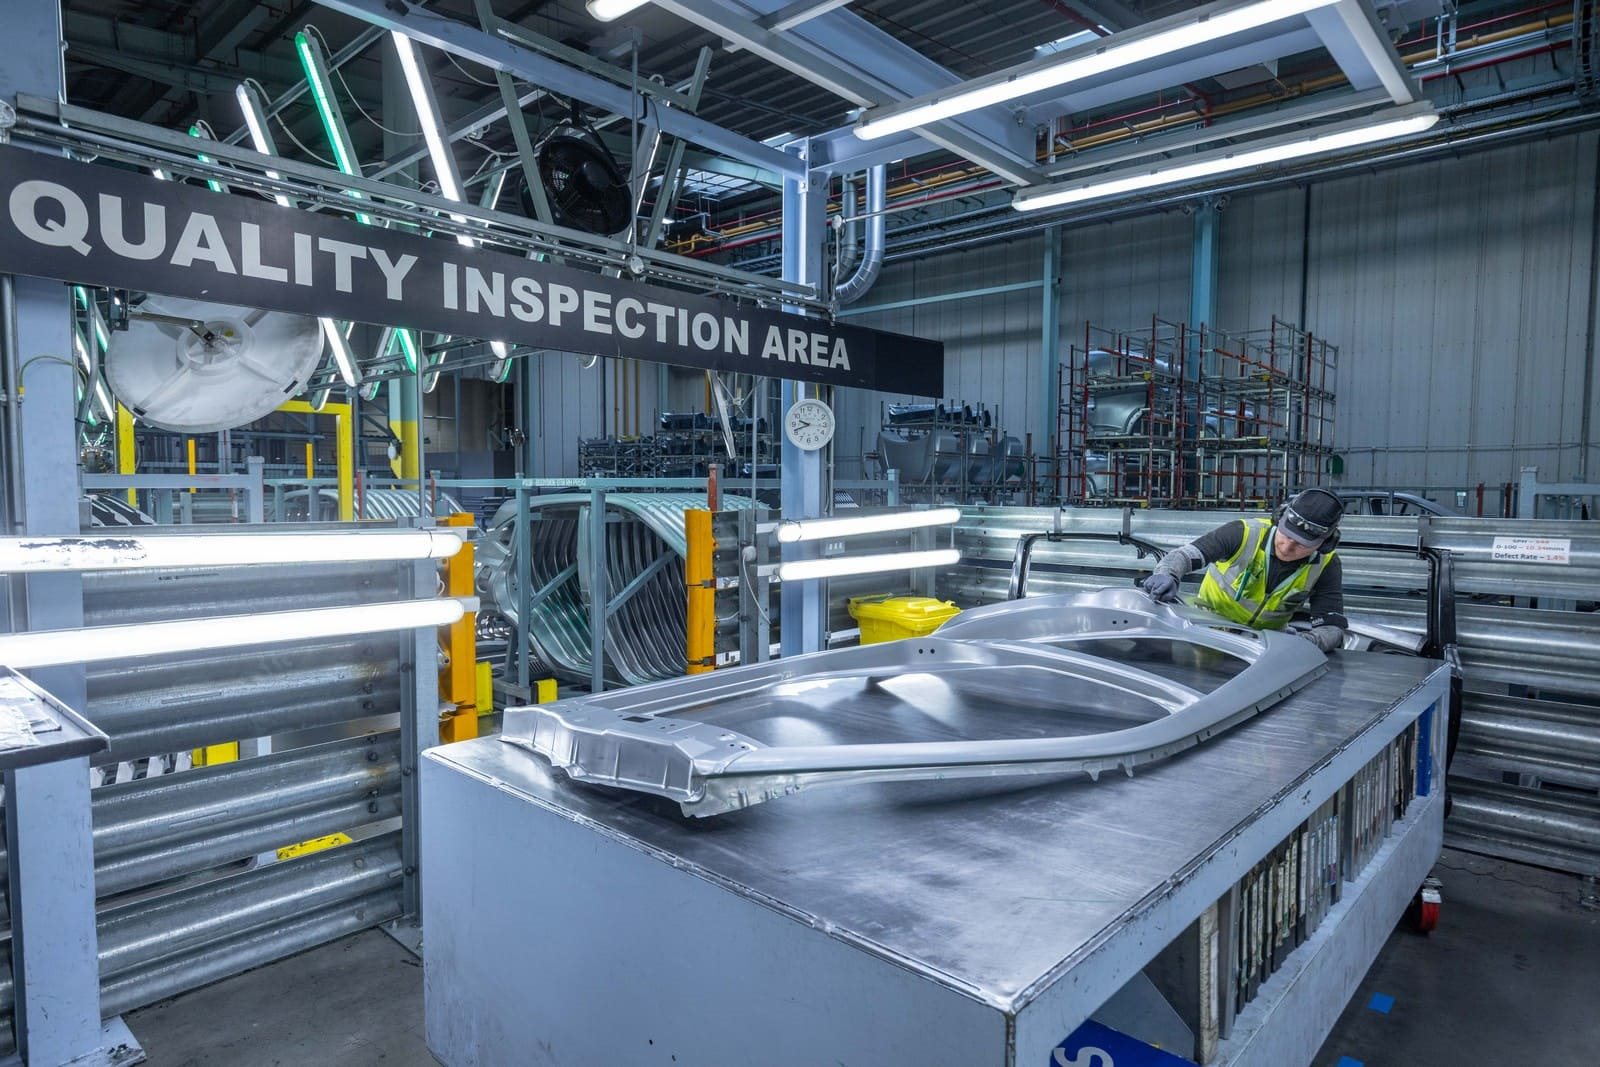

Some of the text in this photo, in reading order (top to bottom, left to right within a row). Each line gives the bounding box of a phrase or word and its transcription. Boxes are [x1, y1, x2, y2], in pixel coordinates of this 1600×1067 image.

[9, 181, 851, 371] QUALITY INSPECTION AREA
[1495, 552, 1519, 560] Defect
[1520, 553, 1538, 561] Rate
